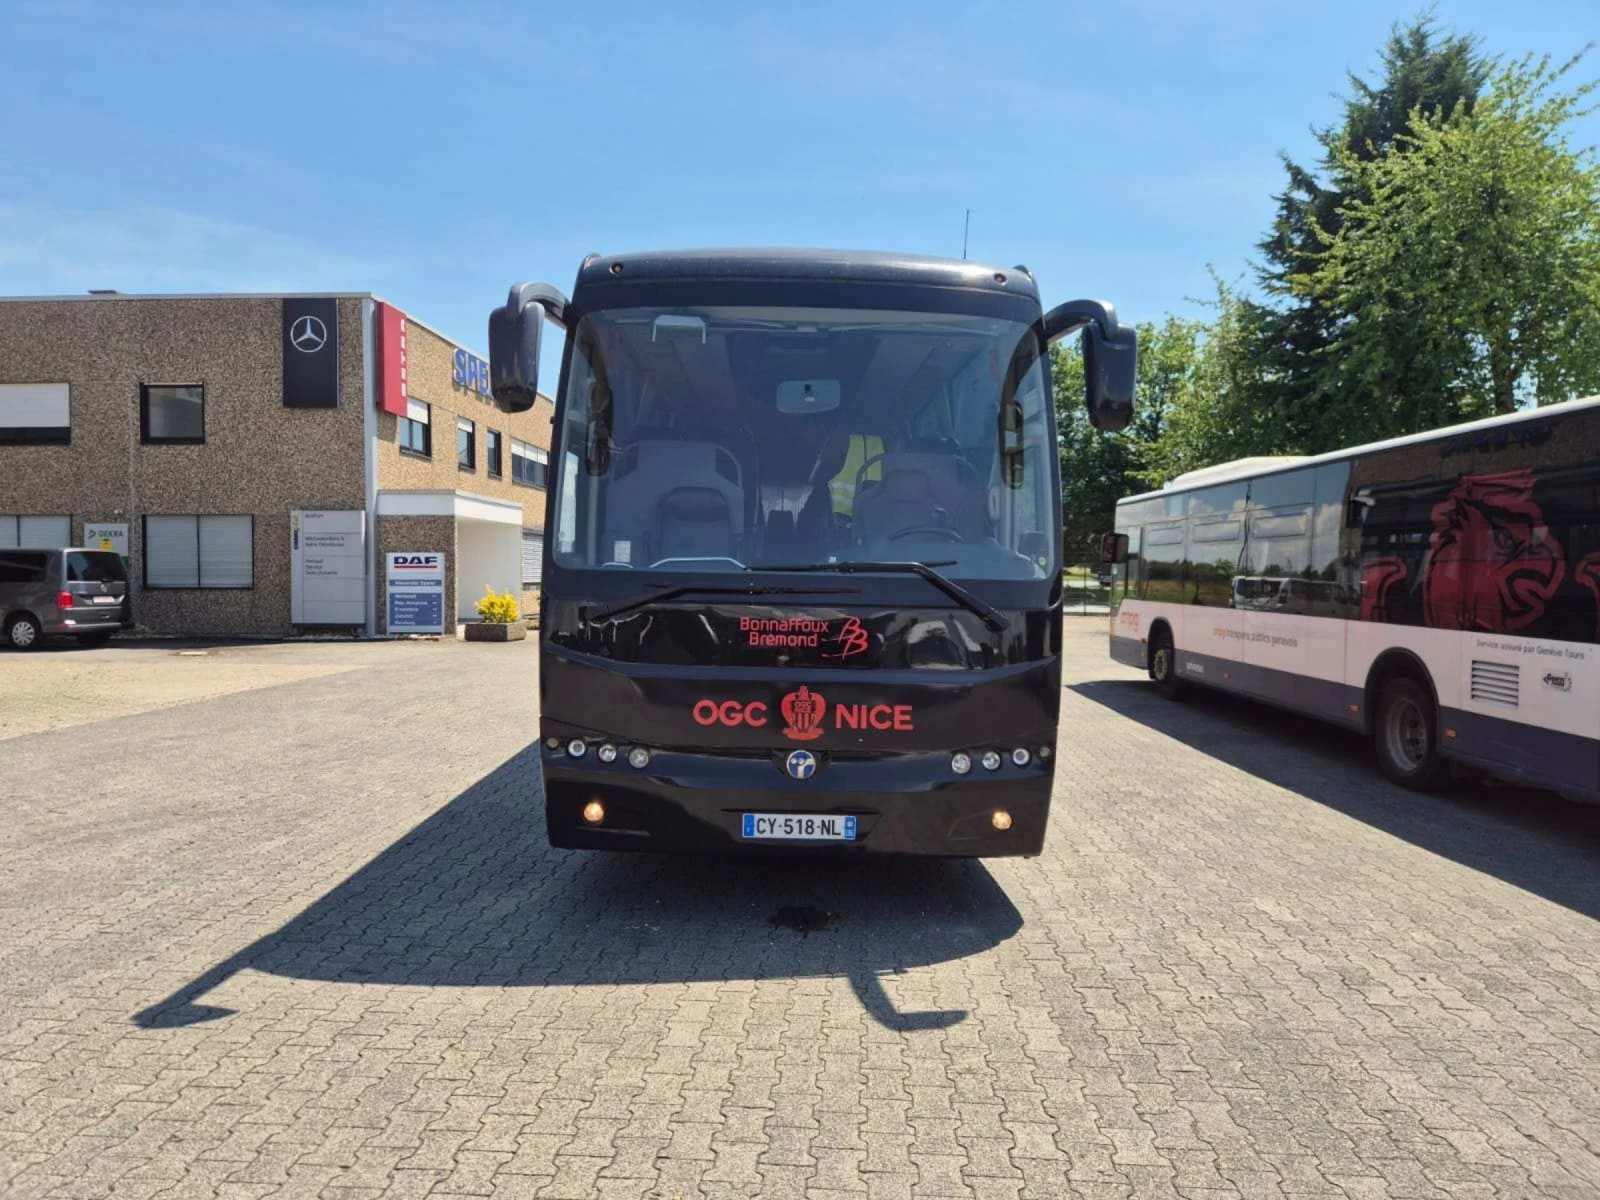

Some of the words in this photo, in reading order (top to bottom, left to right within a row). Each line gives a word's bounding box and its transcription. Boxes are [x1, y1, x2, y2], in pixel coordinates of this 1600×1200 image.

[393, 556, 438, 565] DAF
[740, 616, 829, 633] Bonnaffoux
[1476, 639, 1499, 649] Service
[1523, 645, 1535, 655] par
[1564, 648, 1585, 660] Tours
[692, 699, 768, 727] OGC
[835, 704, 914, 730] NICE
